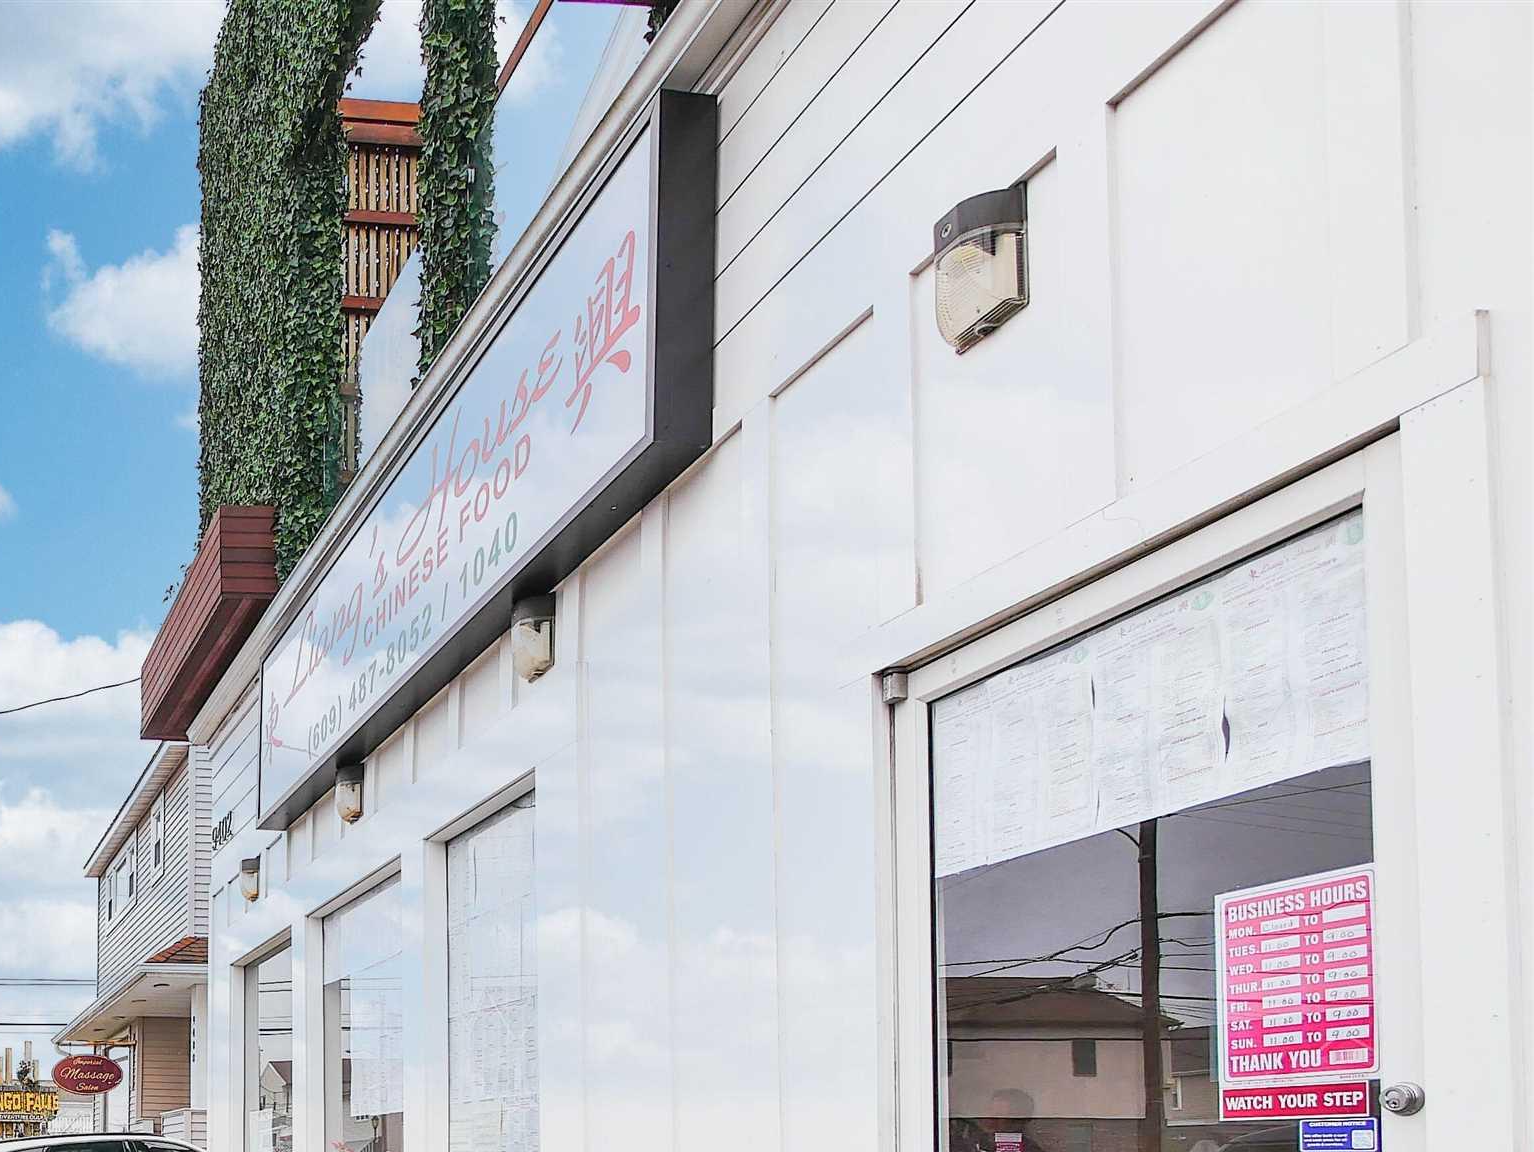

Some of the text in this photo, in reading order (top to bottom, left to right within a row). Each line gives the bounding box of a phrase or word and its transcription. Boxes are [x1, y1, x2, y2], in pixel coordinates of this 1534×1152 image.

[363, 433, 531, 648] CHINESE FOOD
[307, 695, 342, 761] (609)
[348, 602, 432, 711] 487-8052
[458, 511, 518, 600] 1040
[1227, 880, 1367, 923] BUSINESS HOURS
[1228, 926, 1257, 941] MON.
[1304, 914, 1318, 926] TO
[1229, 944, 1260, 958] TUES.
[1304, 933, 1319, 946] TO
[1229, 963, 1257, 977] WED.
[1304, 953, 1320, 965] TO
[1229, 981, 1262, 995] THUR.
[1305, 973, 1320, 985] TO
[1230, 1001, 1251, 1013] FRI.
[1305, 992, 1320, 1004] TO
[1230, 1019, 1253, 1031] SAT.
[1306, 1011, 1322, 1023] TO
[1230, 1037, 1257, 1050] SUN.
[1306, 1031, 1322, 1043] TO
[1229, 1048, 1322, 1073] THANK YOU
[60, 1067, 115, 1083] Massage
[1225, 1090, 1364, 1111] WATCH YOUR STEP
